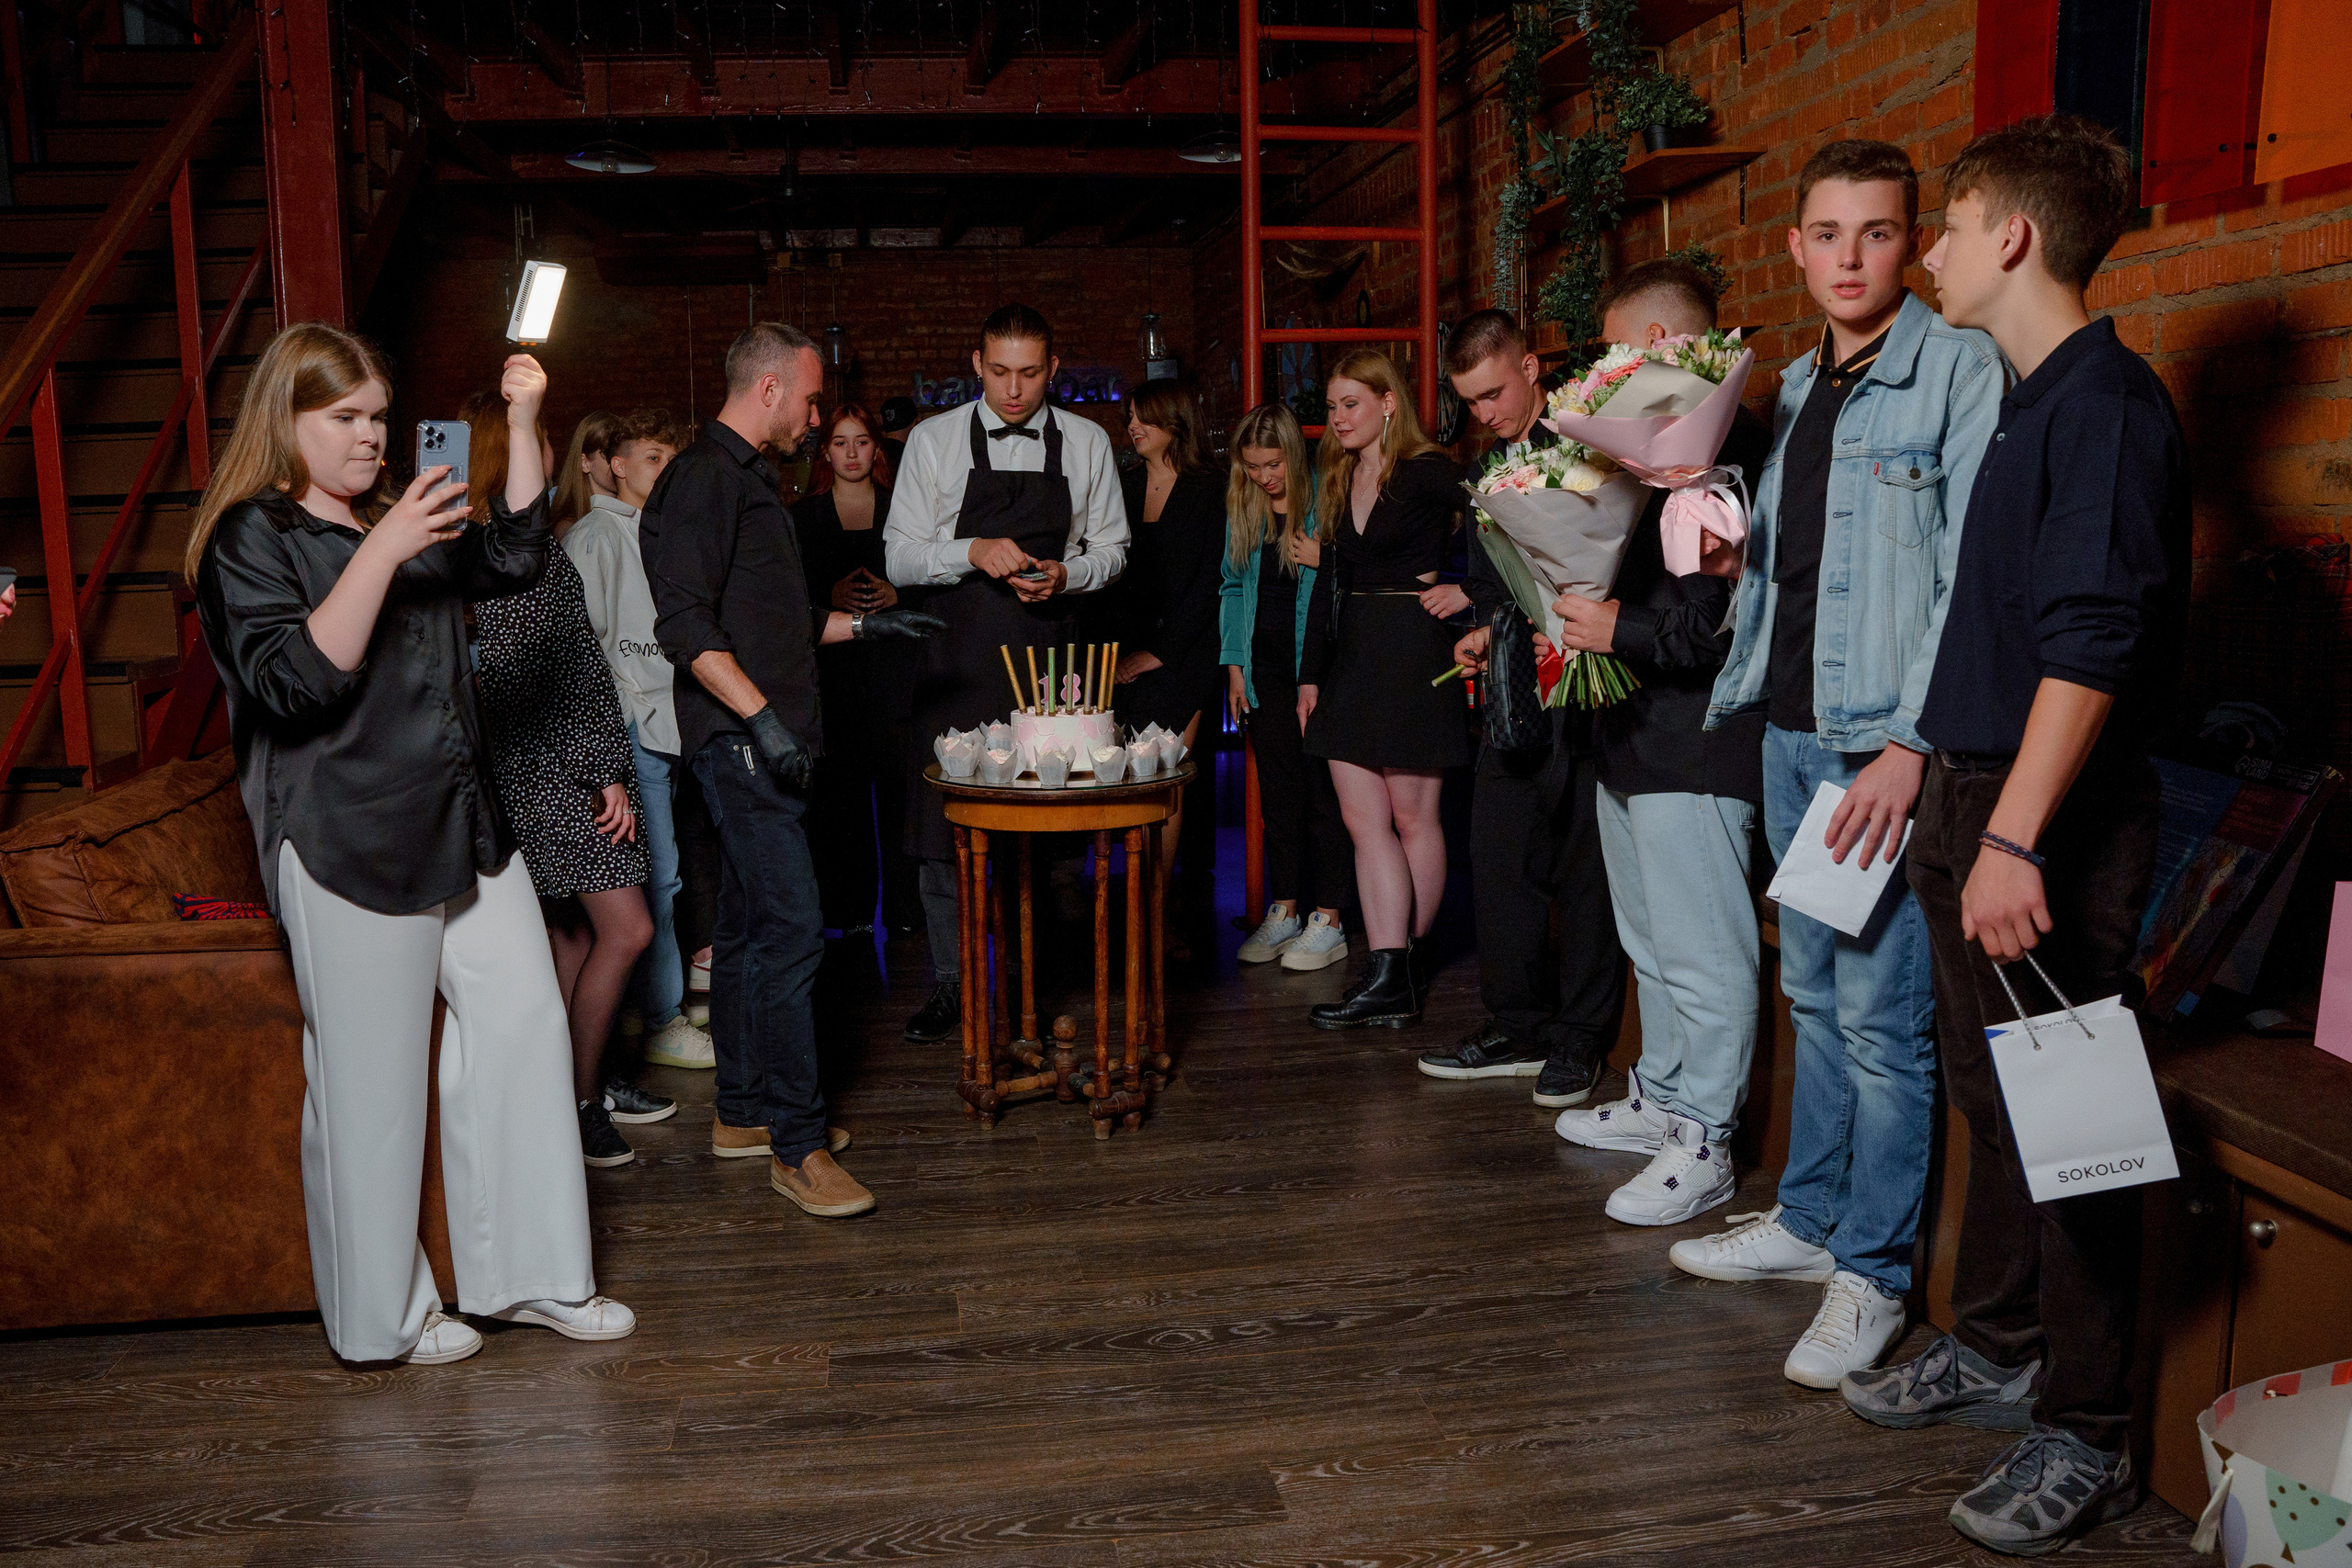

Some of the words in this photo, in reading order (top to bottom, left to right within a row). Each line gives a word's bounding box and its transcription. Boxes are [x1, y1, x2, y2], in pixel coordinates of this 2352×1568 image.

[2250, 757, 2274, 770] SIMA
[2057, 1156, 2145, 1183] SOKOLOV
[1849, 1279, 1862, 1288] HUGO
